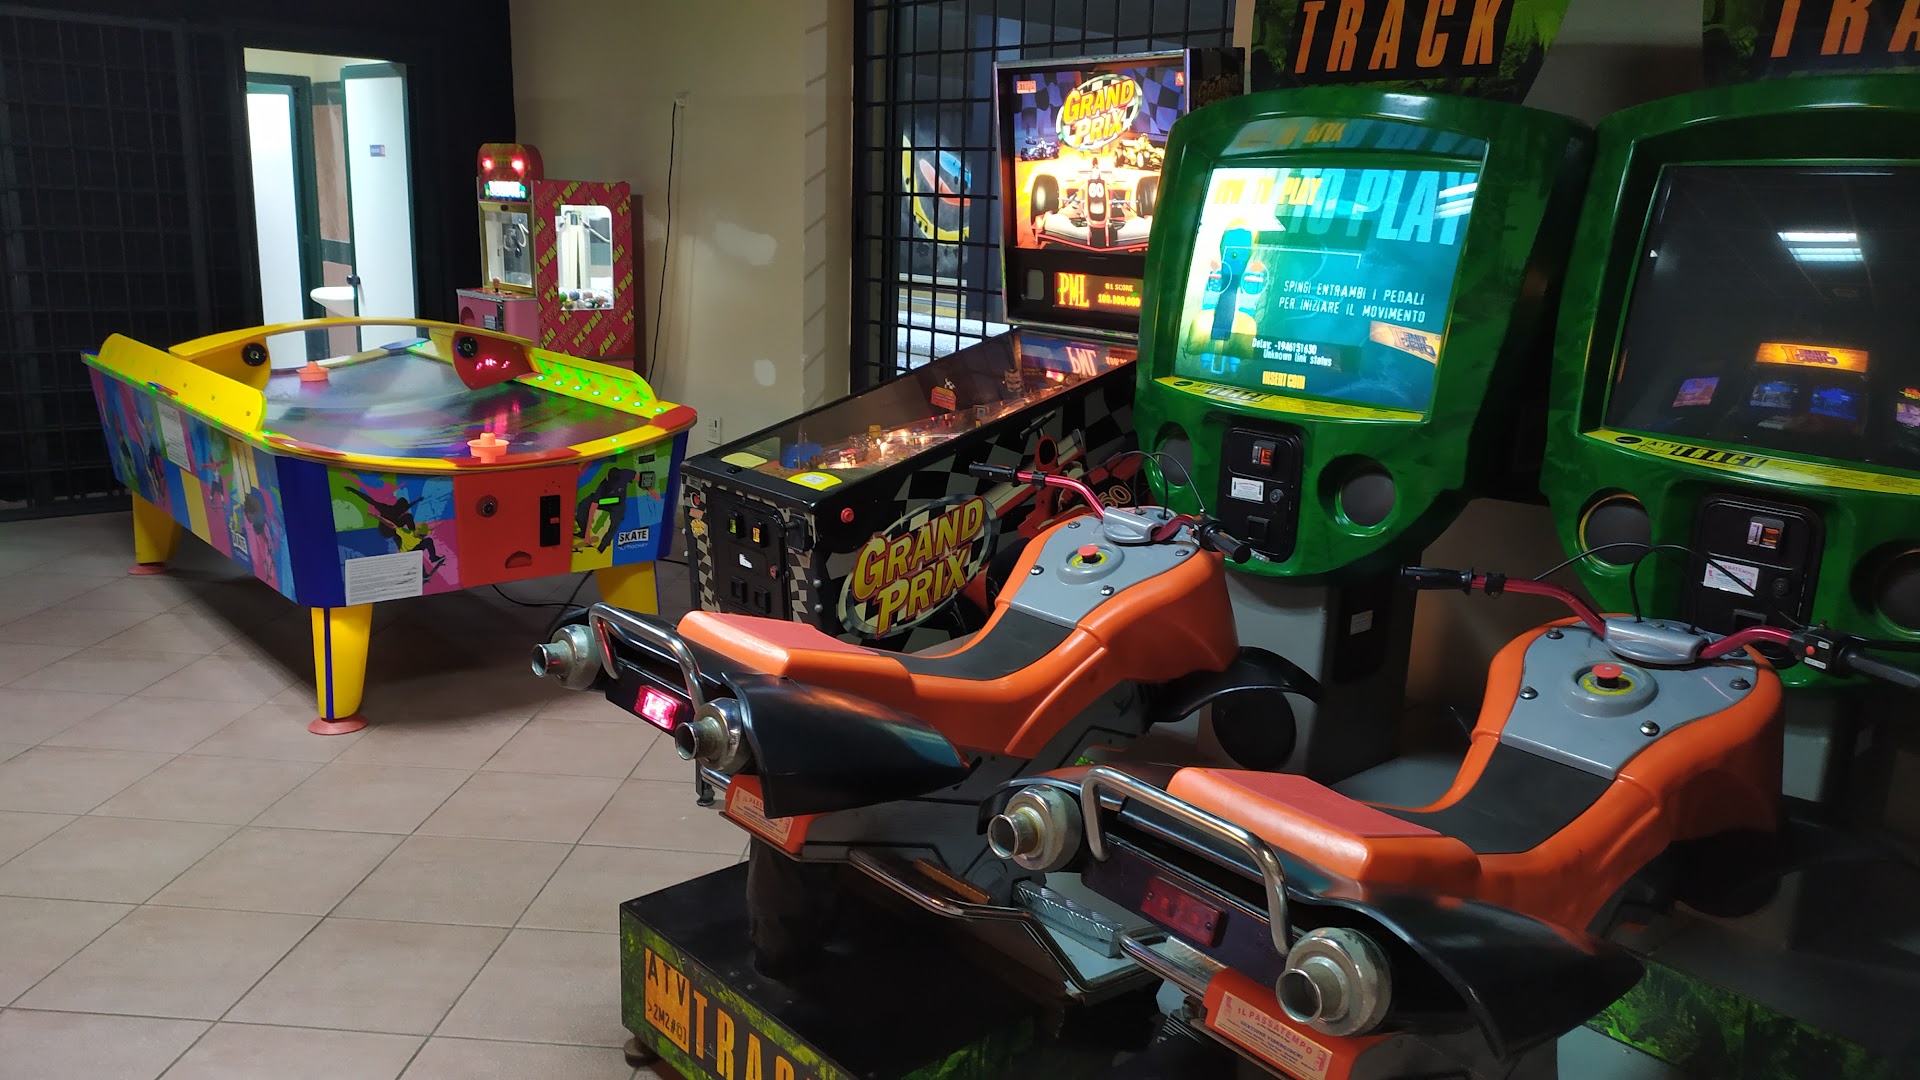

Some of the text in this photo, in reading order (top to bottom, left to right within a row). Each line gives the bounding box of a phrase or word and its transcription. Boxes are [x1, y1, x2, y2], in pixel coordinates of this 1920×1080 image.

[1294, 0, 1501, 74] TRACK
[1063, 79, 1136, 125] GRAND
[1073, 107, 1127, 146] PRIX
[1278, 178, 1323, 205] PLAY
[1346, 168, 1477, 245] PLAY
[1058, 272, 1090, 307] PML
[1283, 280, 1425, 306] SPINGI ENTRAMBI I PEDALI
[1278, 297, 1426, 323] PER INIZIARE IL MOVIMENTO
[1252, 337, 1272, 350] Delay:
[1263, 348, 1333, 367] Unknown link status
[1262, 370, 1306, 390] INSERT COIN
[1675, 446, 1765, 468] TRACK
[619, 530, 647, 542] SKATE
[852, 496, 986, 602] GRAND
[873, 542, 973, 638] PRIX
[647, 951, 686, 1007] ATV
[693, 989, 812, 1080] TRA
[1237, 1007, 1246, 1016] IL
[1248, 1011, 1313, 1055] PASSATEMPO
